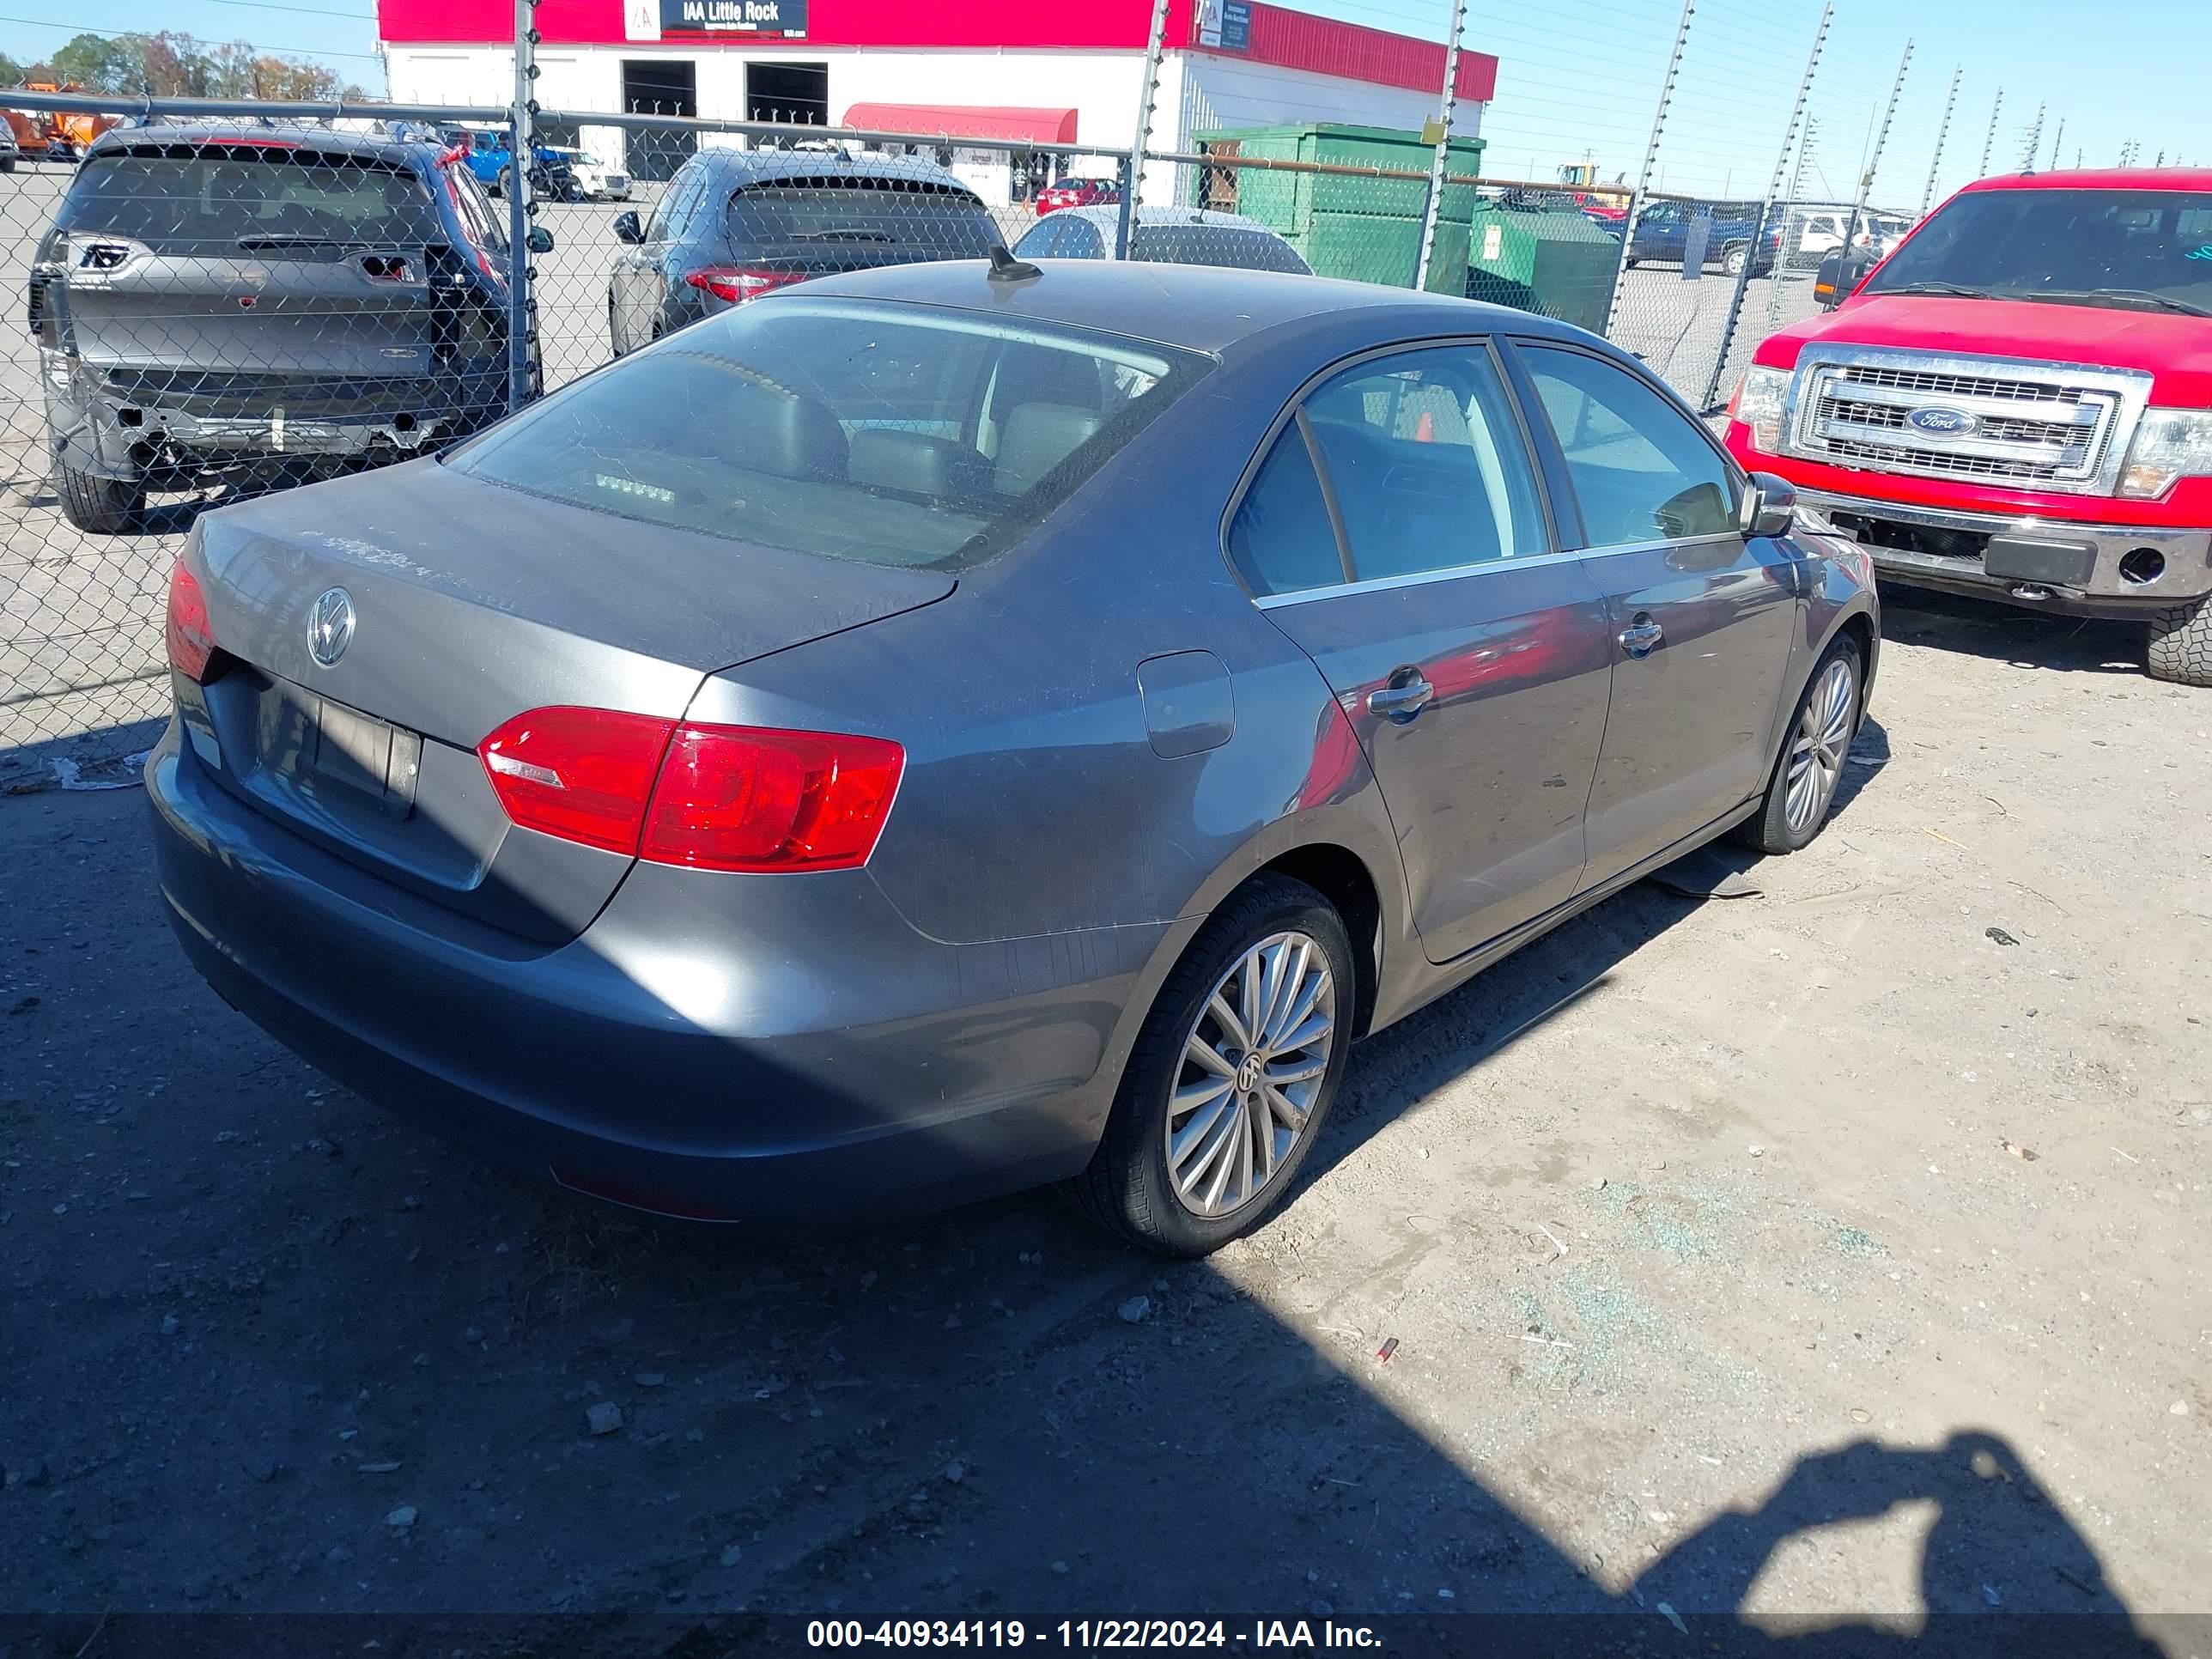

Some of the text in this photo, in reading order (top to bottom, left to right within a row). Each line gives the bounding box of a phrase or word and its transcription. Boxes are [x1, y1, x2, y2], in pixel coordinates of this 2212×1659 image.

[684, 1, 779, 21] IAA Little Rock
[1920, 412, 1958, 428] Ford
